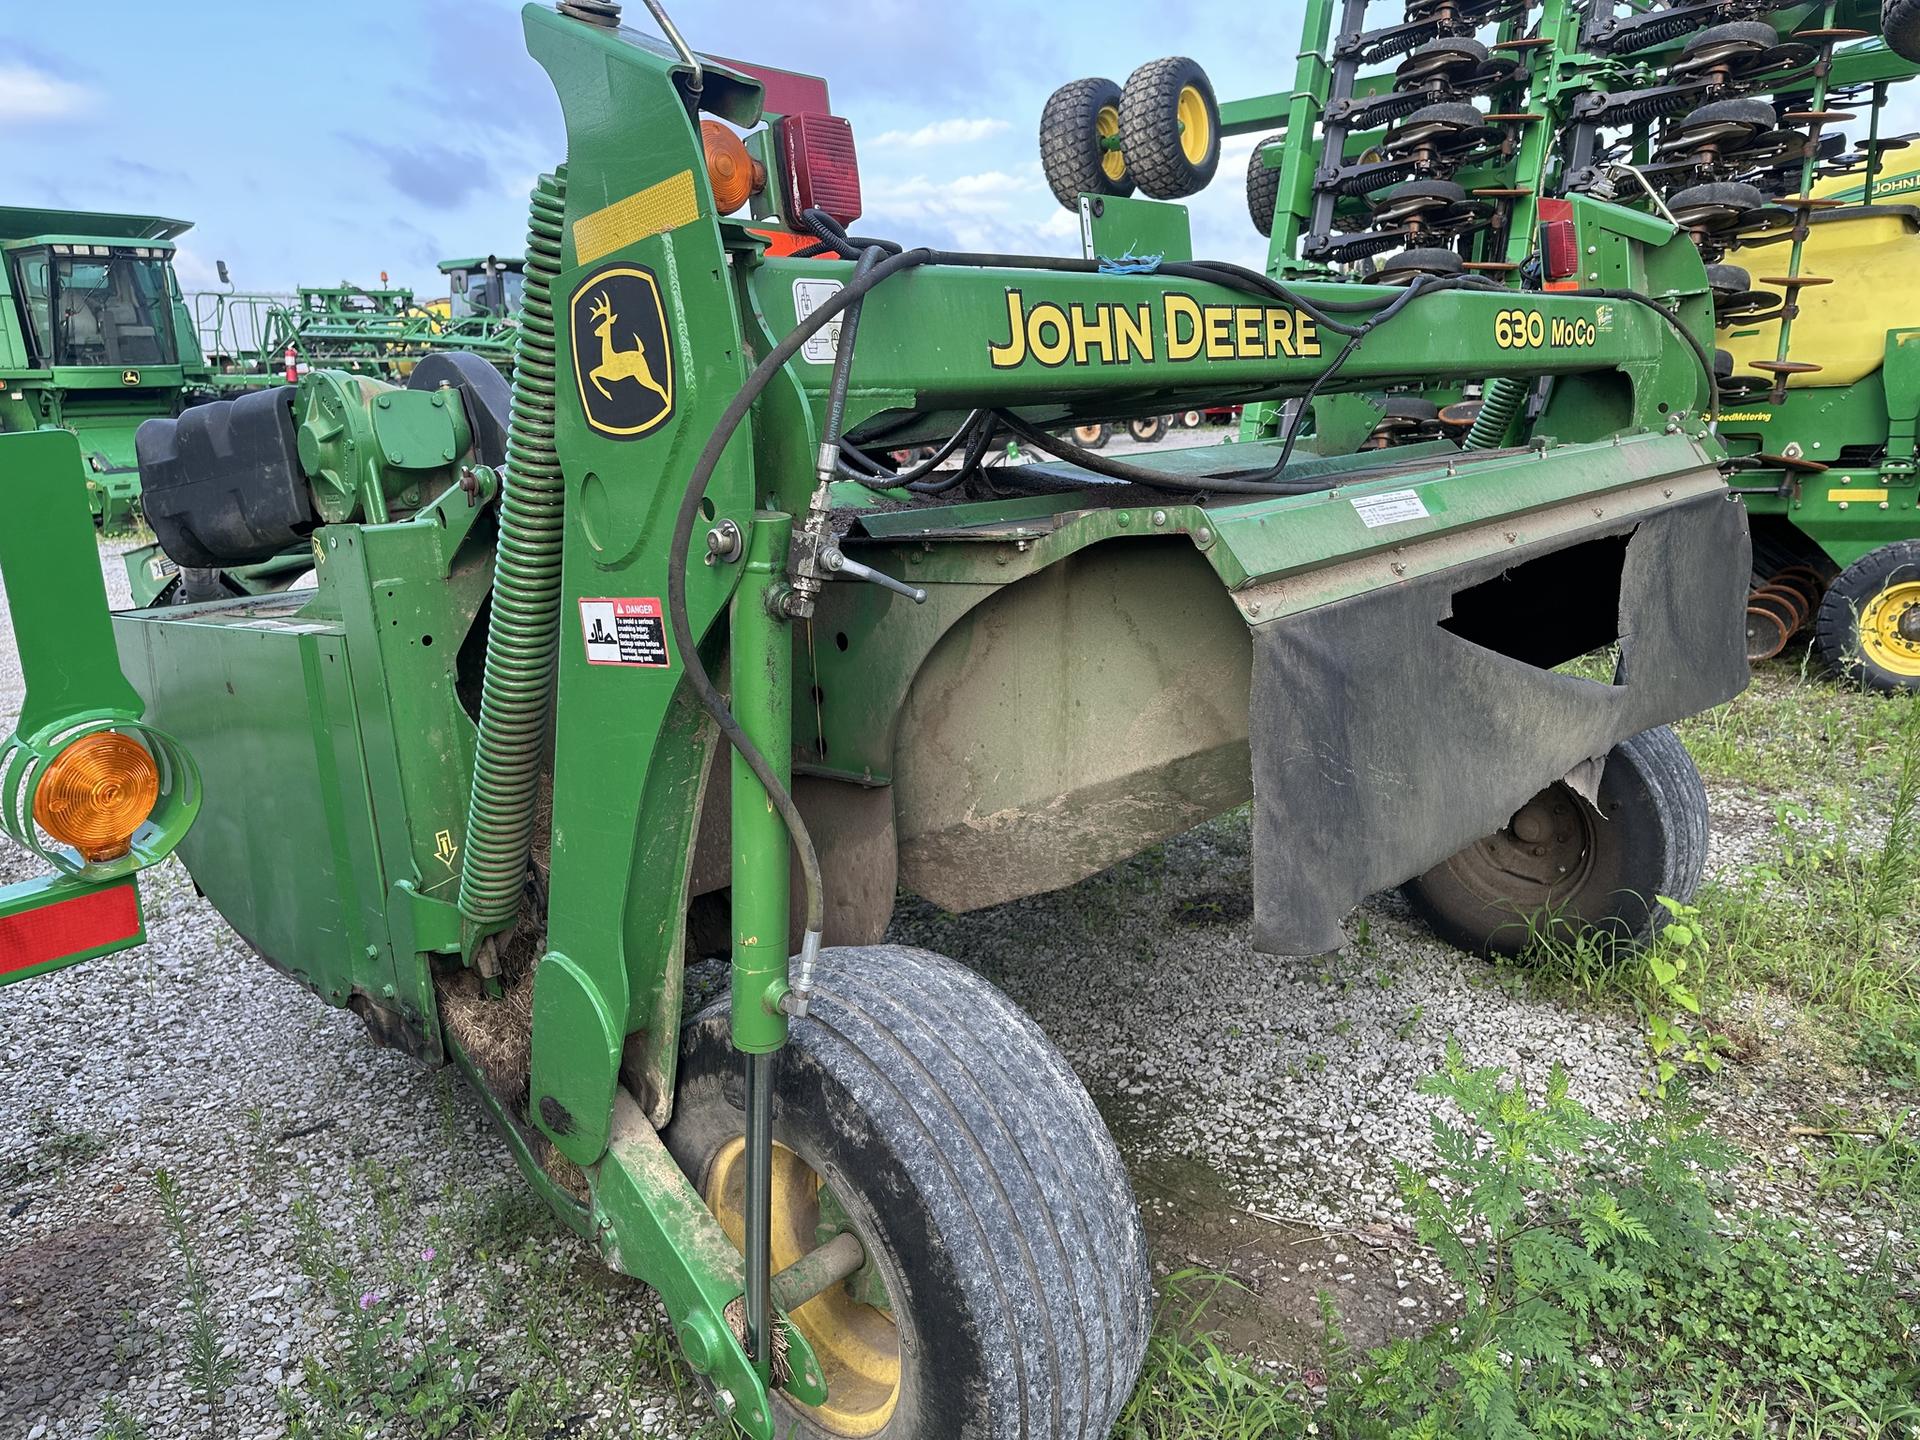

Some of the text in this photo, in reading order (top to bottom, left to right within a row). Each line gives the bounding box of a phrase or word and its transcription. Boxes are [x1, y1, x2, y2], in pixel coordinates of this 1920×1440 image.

[1871, 178, 1914, 195] JOHN
[989, 288, 1322, 369] JOHN DEERE
[1495, 309, 1545, 350] 630
[1550, 317, 1596, 347] MoCo
[828, 400, 842, 441] WINNER
[625, 605, 653, 614] DANGER
